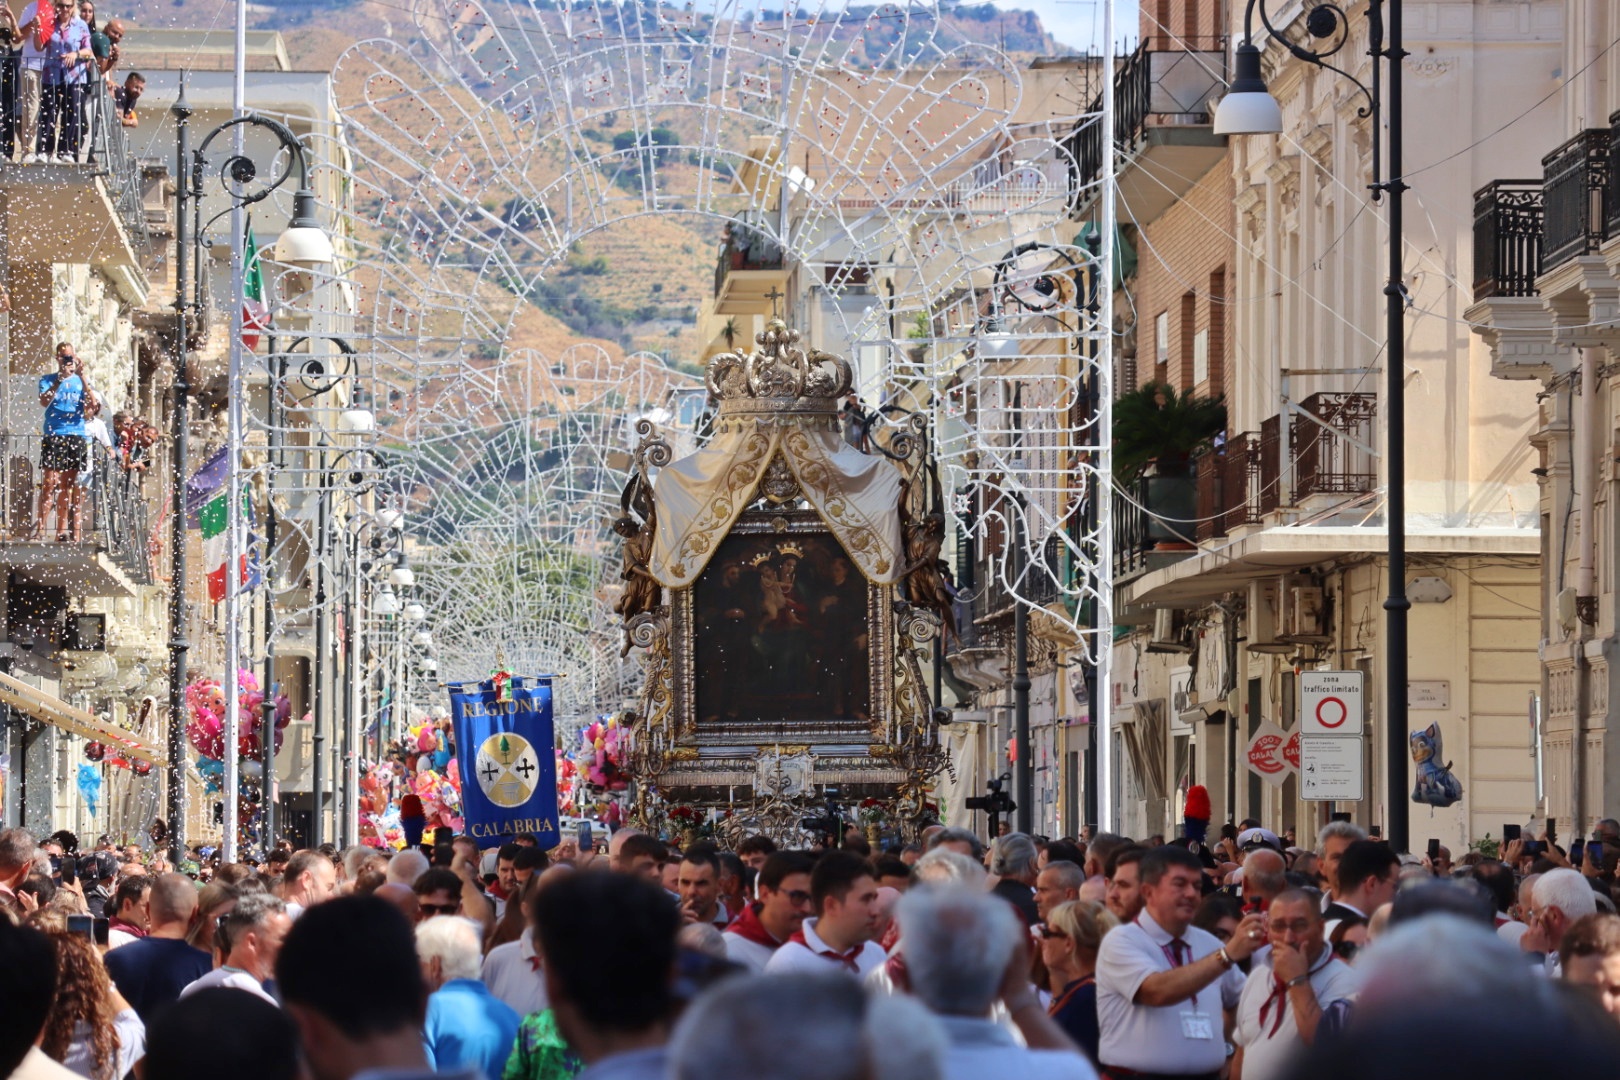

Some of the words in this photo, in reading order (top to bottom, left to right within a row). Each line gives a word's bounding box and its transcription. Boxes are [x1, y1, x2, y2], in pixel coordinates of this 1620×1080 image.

[1304, 685, 1330, 693] traffico
[1331, 685, 1359, 693] limitato
[461, 696, 543, 718] REGIONE
[471, 817, 554, 838] CALABRIA
